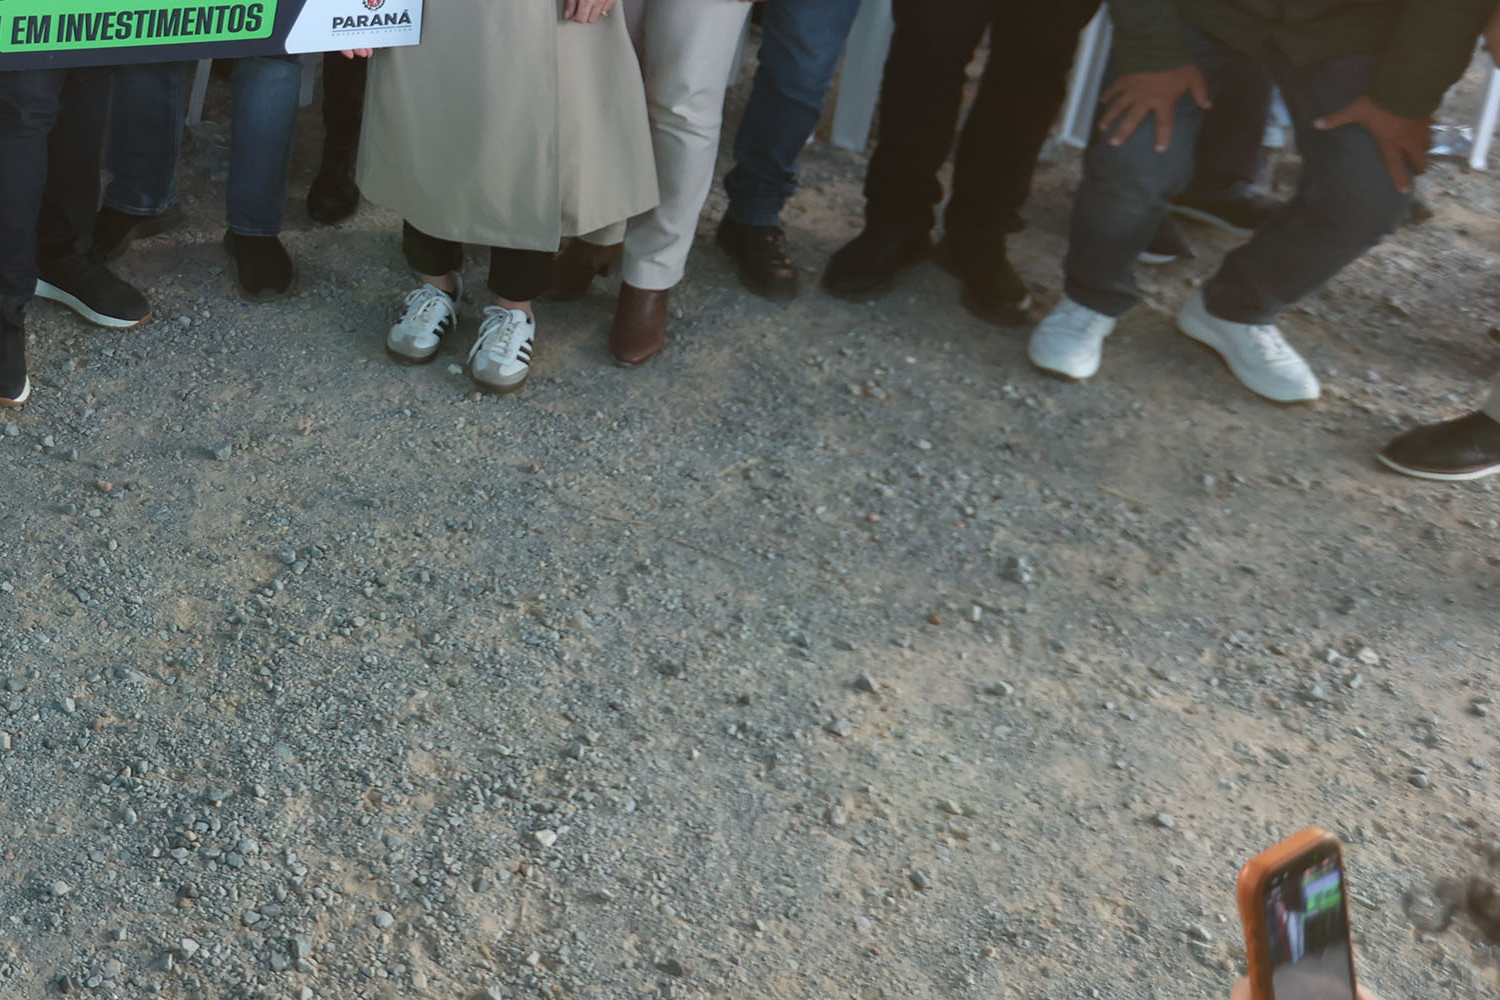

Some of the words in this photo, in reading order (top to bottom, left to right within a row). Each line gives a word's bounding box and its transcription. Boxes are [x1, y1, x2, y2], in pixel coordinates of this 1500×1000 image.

[10, 14, 51, 45] EM
[57, 2, 264, 43] INVESTIMENTOS
[332, 8, 412, 29] PARANÁ
